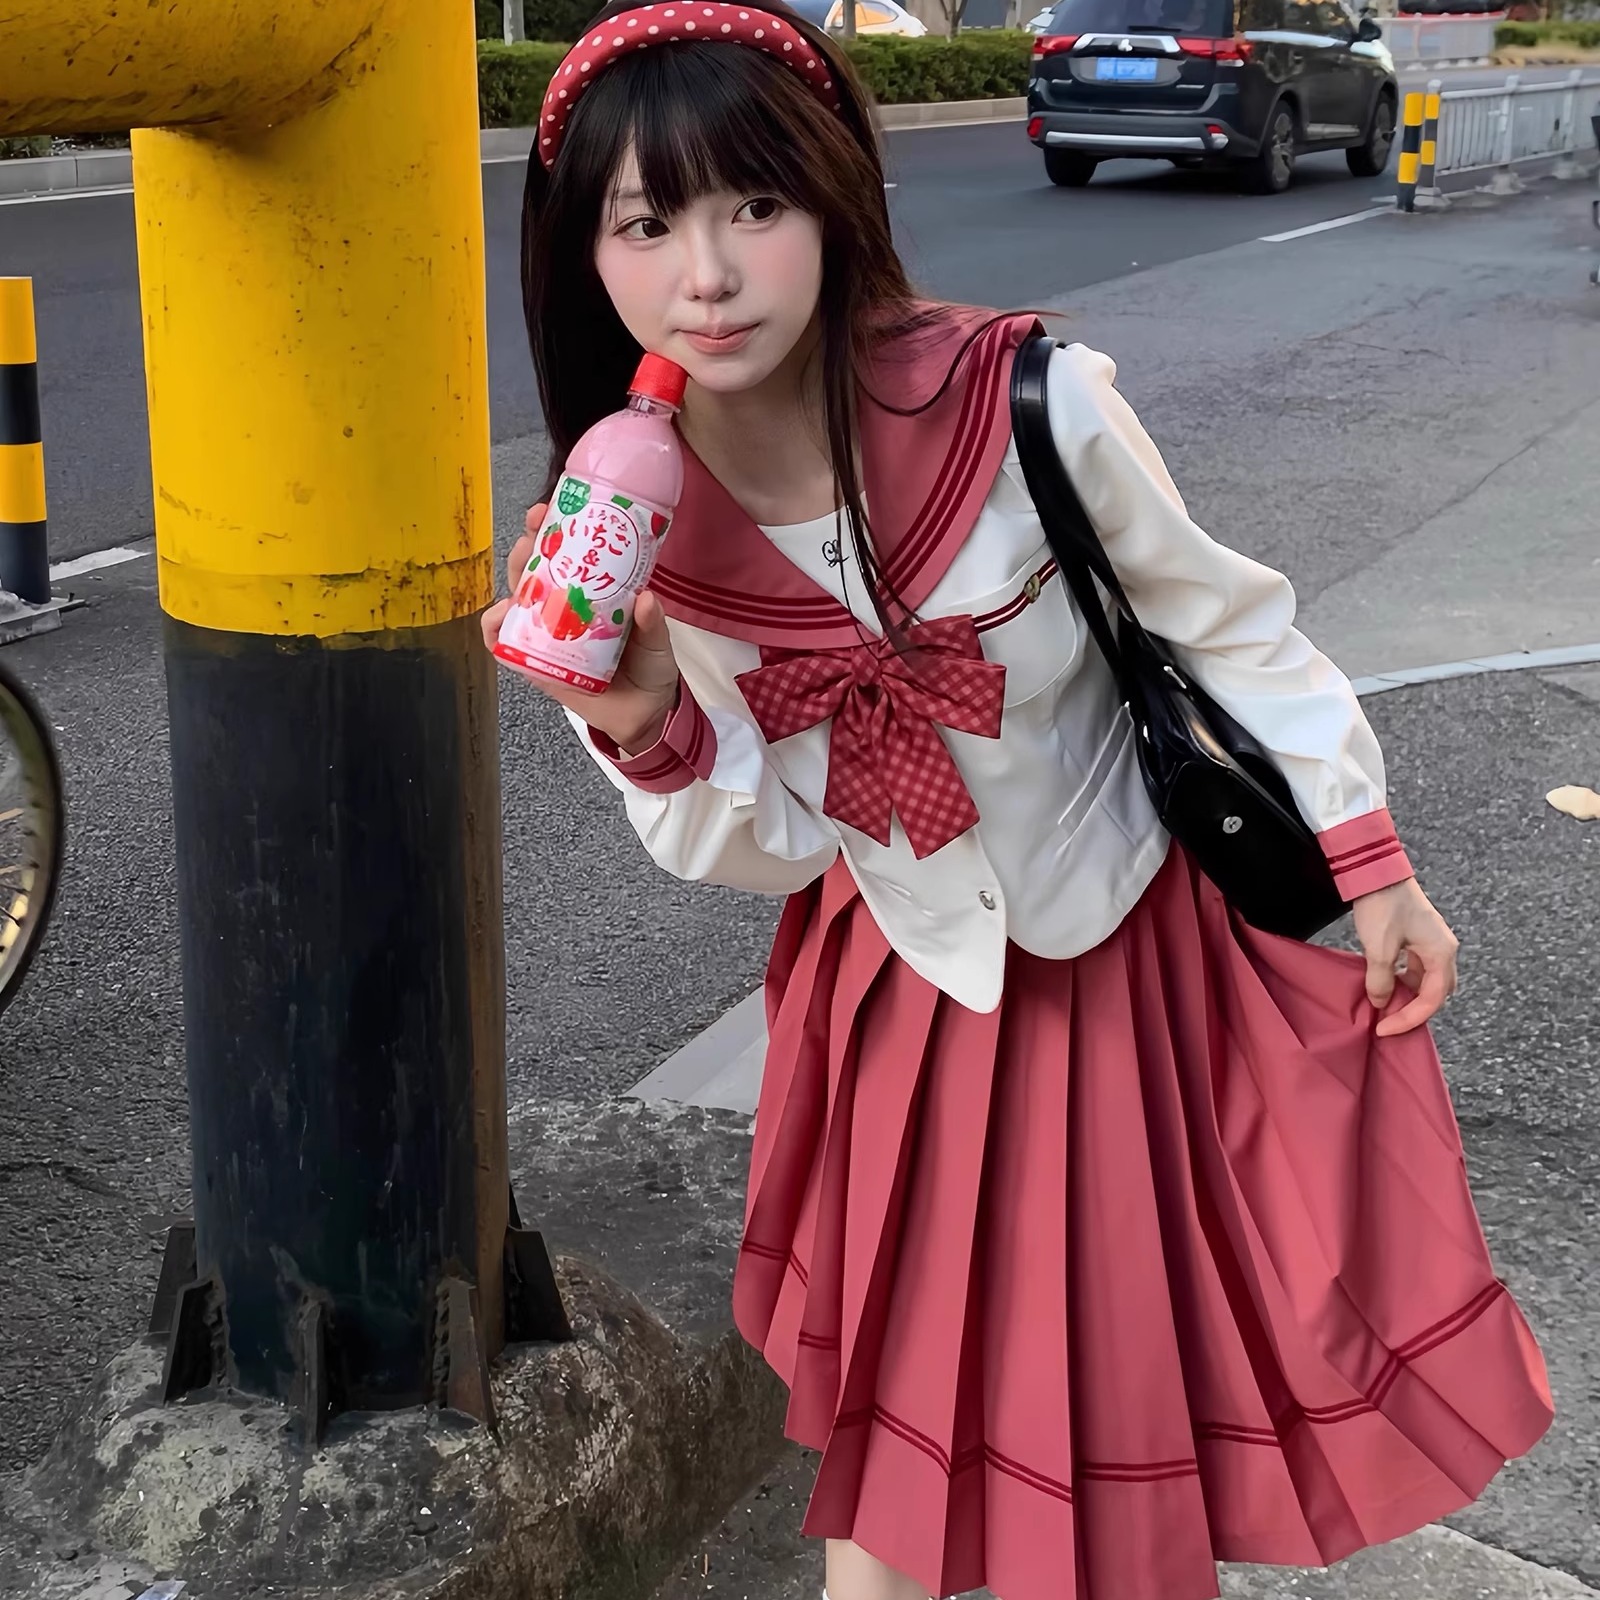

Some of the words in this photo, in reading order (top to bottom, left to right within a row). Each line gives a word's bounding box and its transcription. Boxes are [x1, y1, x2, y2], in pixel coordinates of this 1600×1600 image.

[569, 517, 632, 556] いちご
[556, 555, 616, 592] ミルク
[582, 548, 600, 567] &
